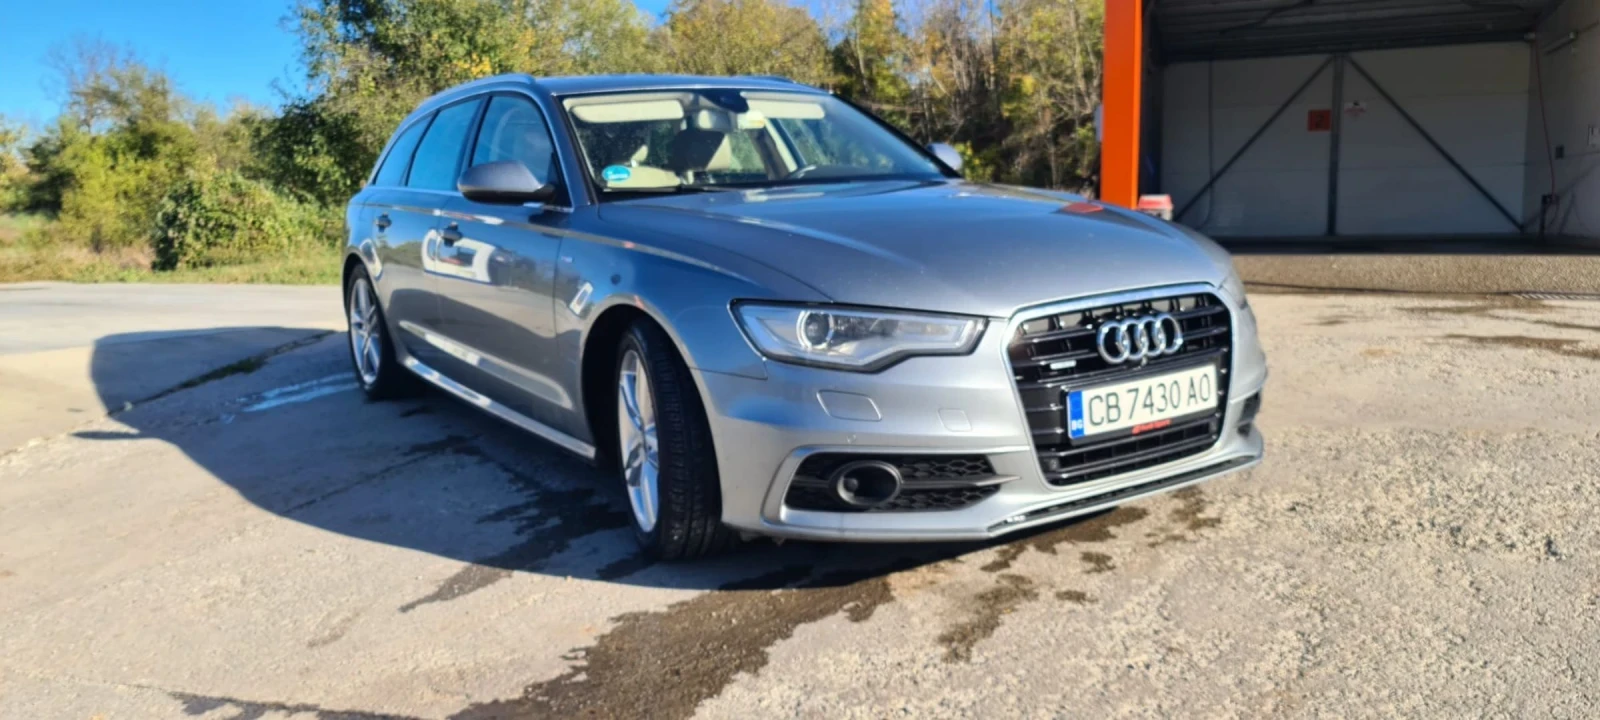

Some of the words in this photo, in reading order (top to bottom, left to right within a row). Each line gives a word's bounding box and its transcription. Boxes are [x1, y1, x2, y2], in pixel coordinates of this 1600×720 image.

[1088, 392, 1121, 426] CB
[1126, 380, 1181, 420] 7430
[1187, 373, 1211, 406] AO
